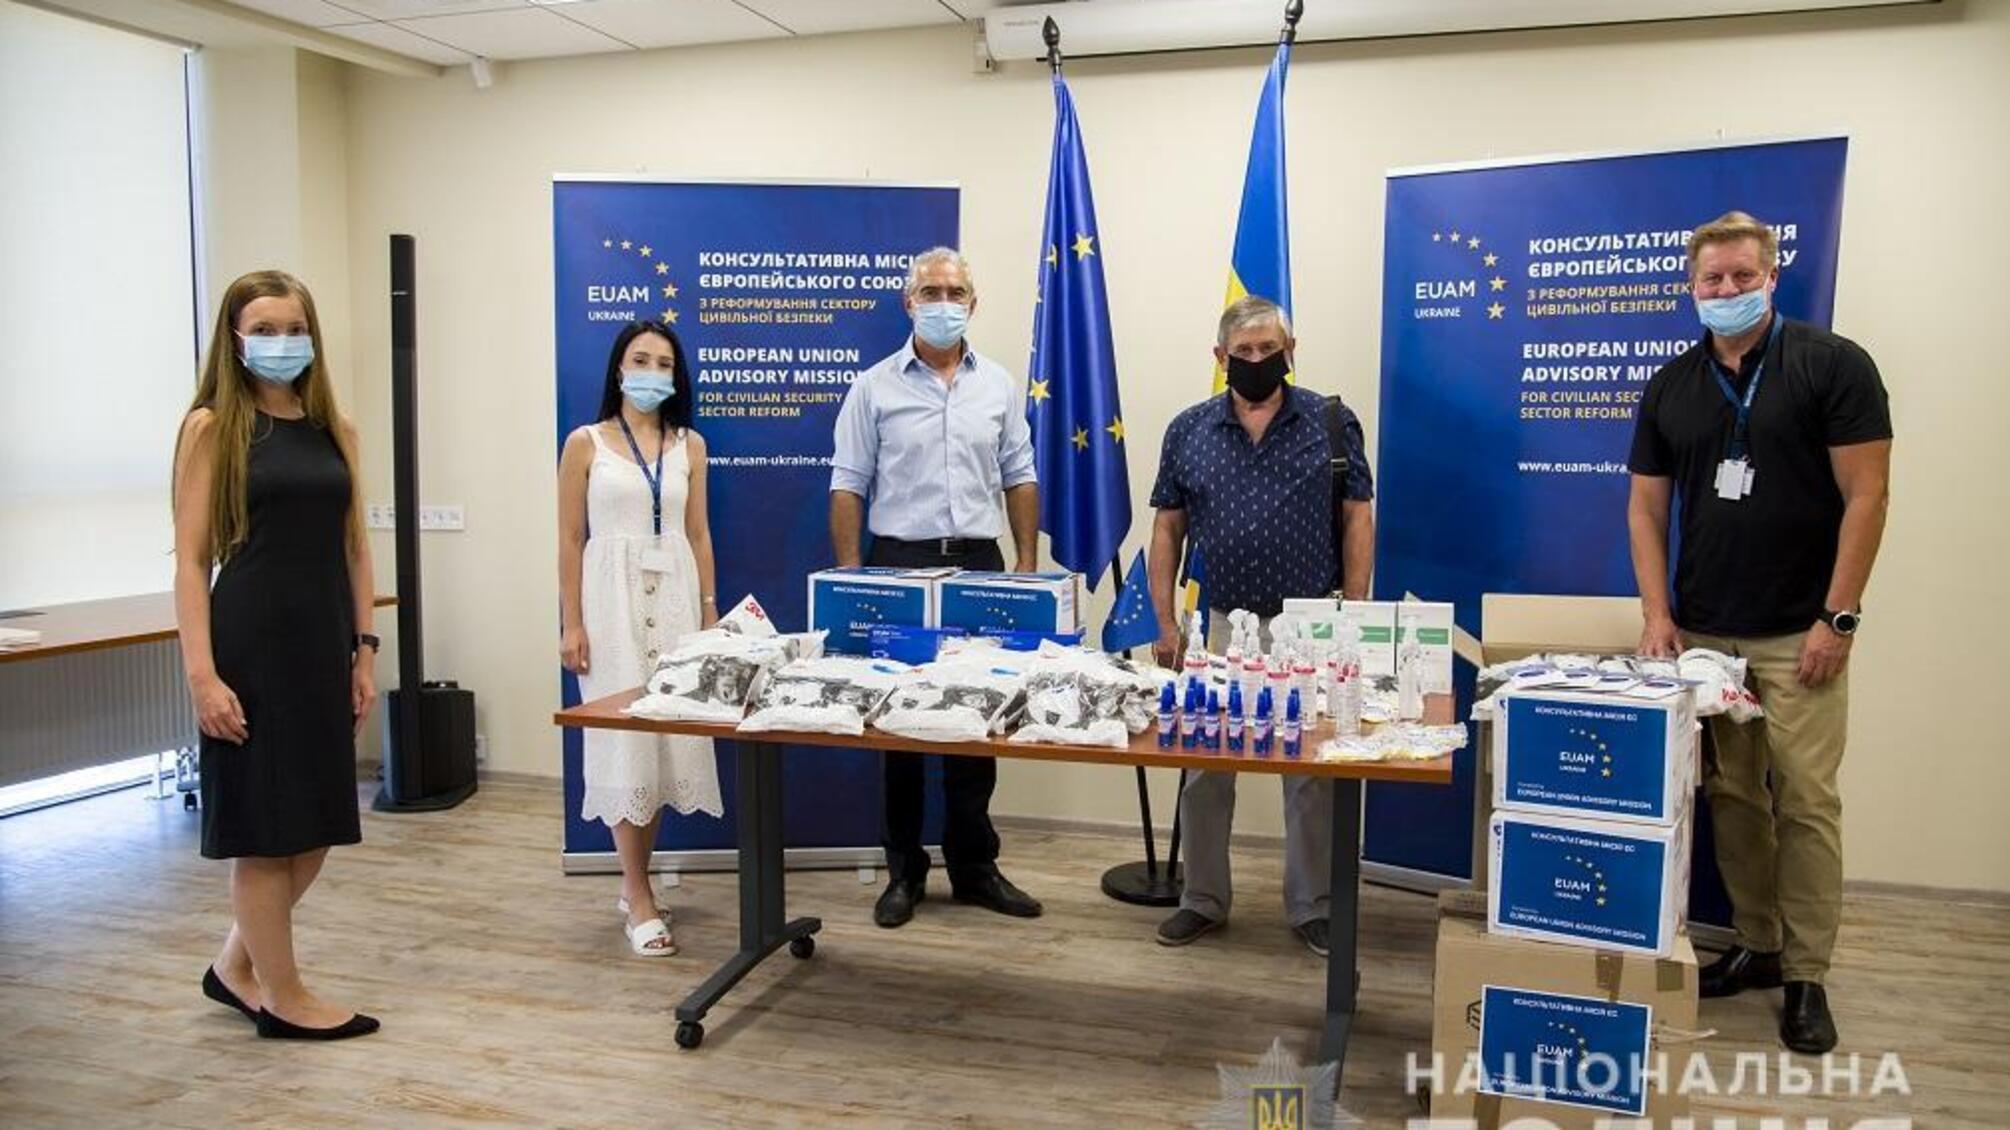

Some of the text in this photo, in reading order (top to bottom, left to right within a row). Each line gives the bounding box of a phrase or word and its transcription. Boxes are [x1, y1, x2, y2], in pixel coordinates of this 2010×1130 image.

[1529, 230, 1693, 255] КОНСУЛЬТАТИВ
[700, 252, 915, 269] КОНСУЛЬТАТИВНА МІСІ
[1529, 254, 1688, 278] ЄВРОПЕЙСЬКОГ
[700, 270, 910, 289] ЄВРОПЕЙСЬКОГО СОЮ
[588, 286, 649, 303] EUAM
[1415, 280, 1475, 299] EUAM
[1539, 284, 1658, 300] РЕФОРМУВАННЯ
[711, 298, 817, 310] РЕФОРМУВАННЯ
[821, 299, 876, 310] СЕКТОРУ
[1527, 300, 1677, 318] ЦИВІЛЬНОЇ БЕЗПЕКИ
[588, 310, 636, 321] UKRAINE
[699, 312, 833, 325] ЦИВІЛЬНОЇ БЕЗПЕКИ
[1414, 306, 1461, 319] UKRAINE
[698, 348, 860, 363] EUROPEAN UNION
[1522, 342, 1628, 359] EUROPEAN
[698, 369, 789, 383] ADVISORY
[1521, 365, 1622, 382] ADVISORY
[699, 392, 842, 403] FOR CIVILIAN SECURITY
[1520, 391, 1549, 403] FOR
[1551, 391, 1611, 403] CIVILIAN
[699, 407, 800, 417] SECTOR REFORM
[1520, 408, 1632, 419] SECTOR REFORM
[1517, 461, 1632, 473] www.euam-ukra
[1559, 751, 1595, 764] EUAM
[1554, 877, 1590, 892] EUAM
[1537, 1043, 1573, 1058] EUAM
